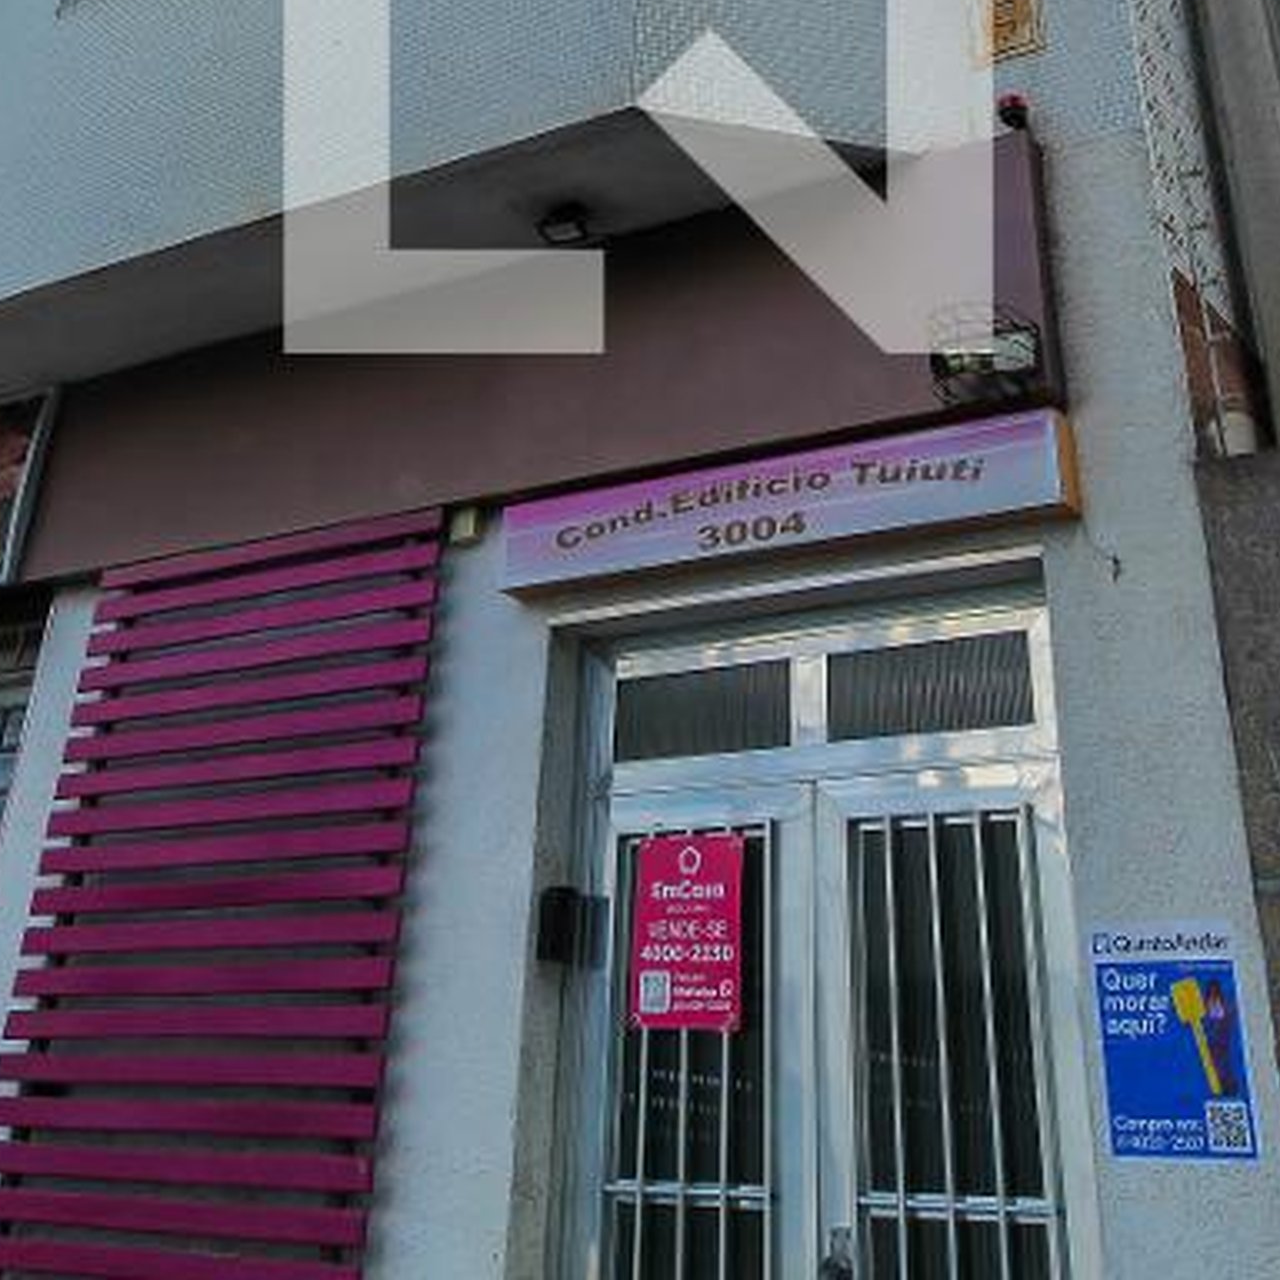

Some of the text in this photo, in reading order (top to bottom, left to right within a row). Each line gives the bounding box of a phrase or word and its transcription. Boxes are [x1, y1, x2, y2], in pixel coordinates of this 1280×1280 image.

[850, 456, 987, 486] Tuiuti
[696, 510, 809, 551] 3004
[650, 880, 726, 900] EmCasa
[646, 919, 729, 940] VENDE-SE
[1101, 967, 1158, 991] Quer
[1103, 993, 1169, 1012] morar
[1105, 1011, 1168, 1039] aqui?
